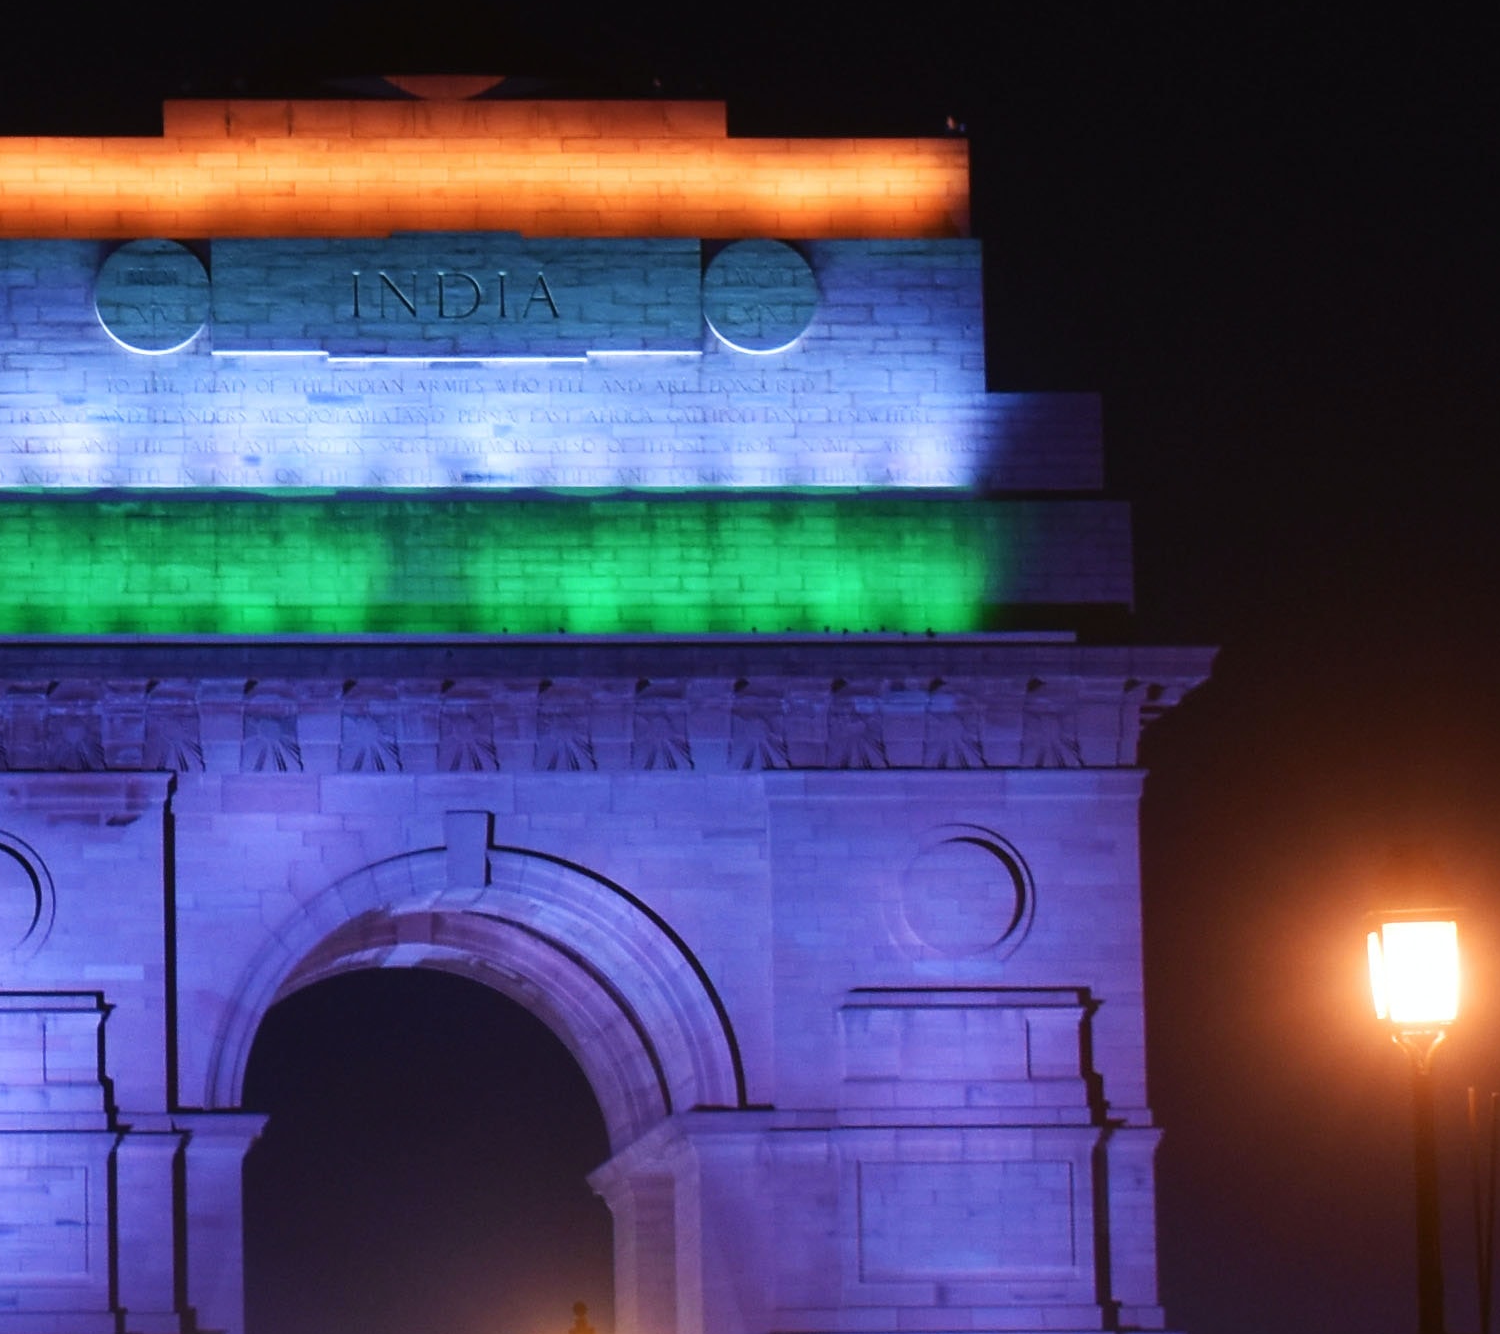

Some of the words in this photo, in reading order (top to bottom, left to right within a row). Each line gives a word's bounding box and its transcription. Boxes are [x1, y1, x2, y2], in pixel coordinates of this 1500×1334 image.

[352, 271, 560, 318] INDIA
[104, 377, 130, 393] TO
[141, 377, 178, 393] THE
[194, 377, 246, 393] DEAD
[255, 377, 277, 393] OF
[291, 377, 325, 393] THE
[337, 377, 404, 393] INDIAN
[416, 377, 484, 393] ARMIES
[495, 377, 540, 393] WHO
[601, 377, 643, 393] AND
[655, 377, 689, 393] ARE
[100, 409, 142, 424] AND
[152, 409, 248, 424] FLANDERS
[259, 409, 392, 424] MESOPOTAMIA
[403, 409, 446, 424] AND
[588, 409, 655, 424] AFRICA
